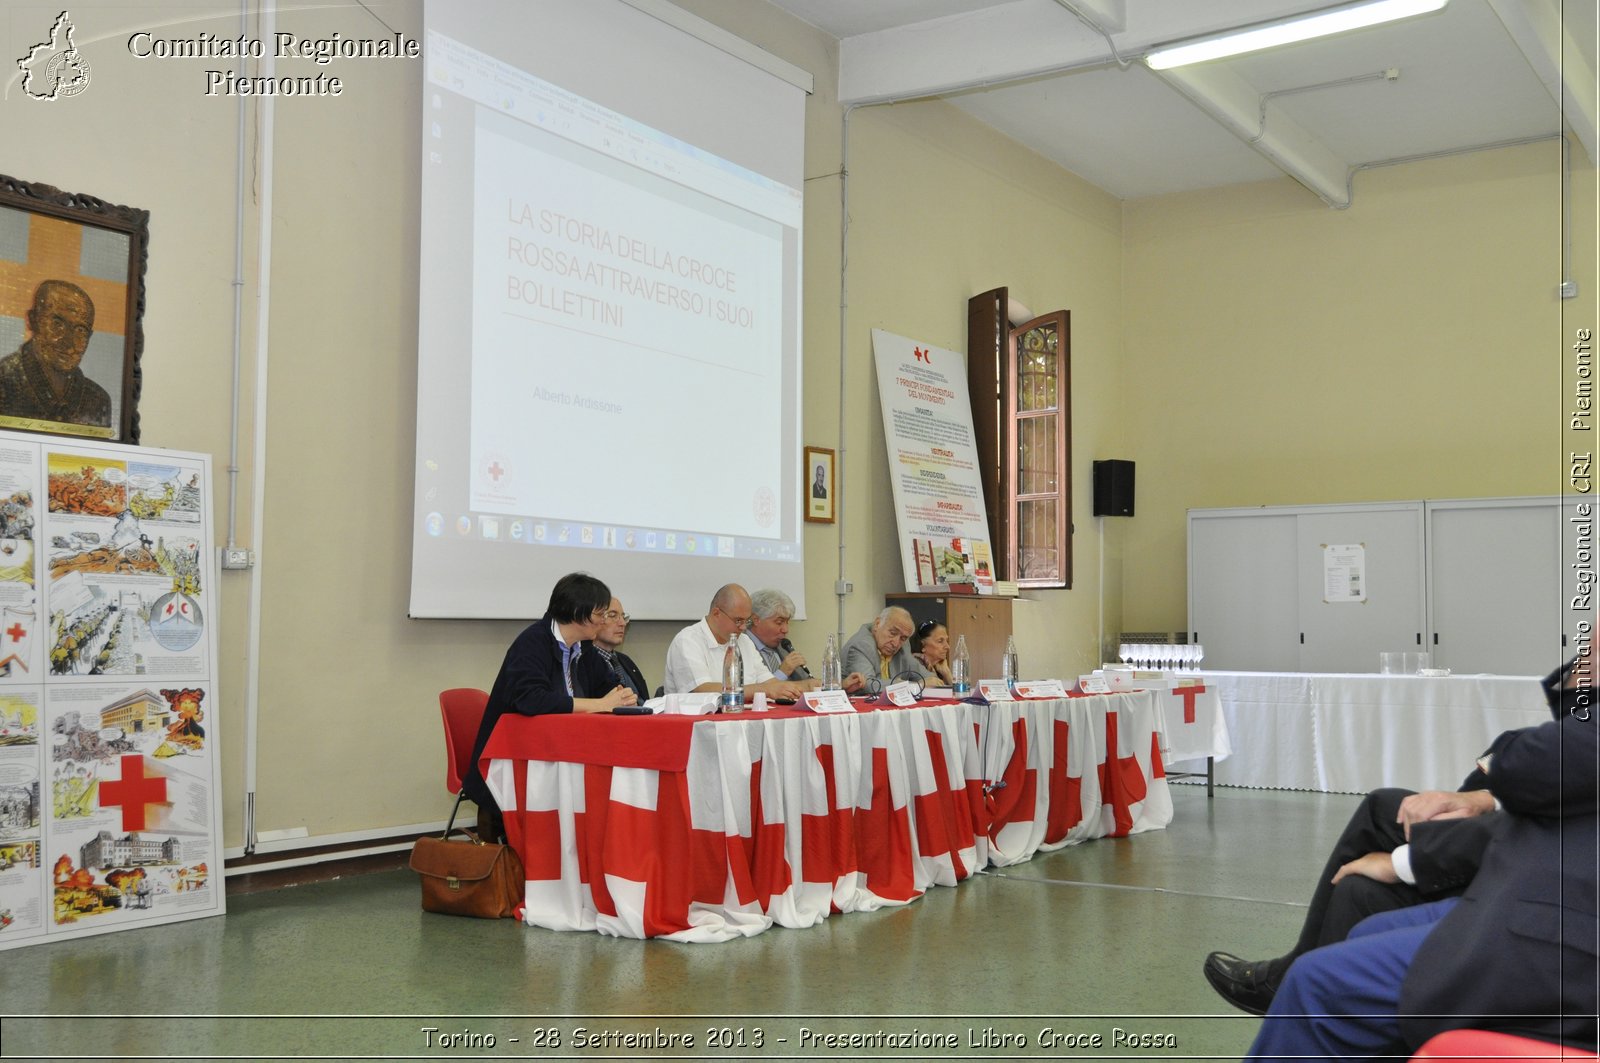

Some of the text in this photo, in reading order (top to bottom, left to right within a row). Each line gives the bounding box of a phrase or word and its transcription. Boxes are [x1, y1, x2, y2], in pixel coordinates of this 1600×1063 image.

[508, 197, 737, 293] LA STORIA DELLA CROCE
[507, 236, 582, 280] ROSSA
[584, 260, 704, 314] ATTRAVERSO
[716, 300, 754, 329] SUOI
[507, 275, 624, 328] BOLLETTINI
[532, 385, 623, 414] Alberto Ardissone
